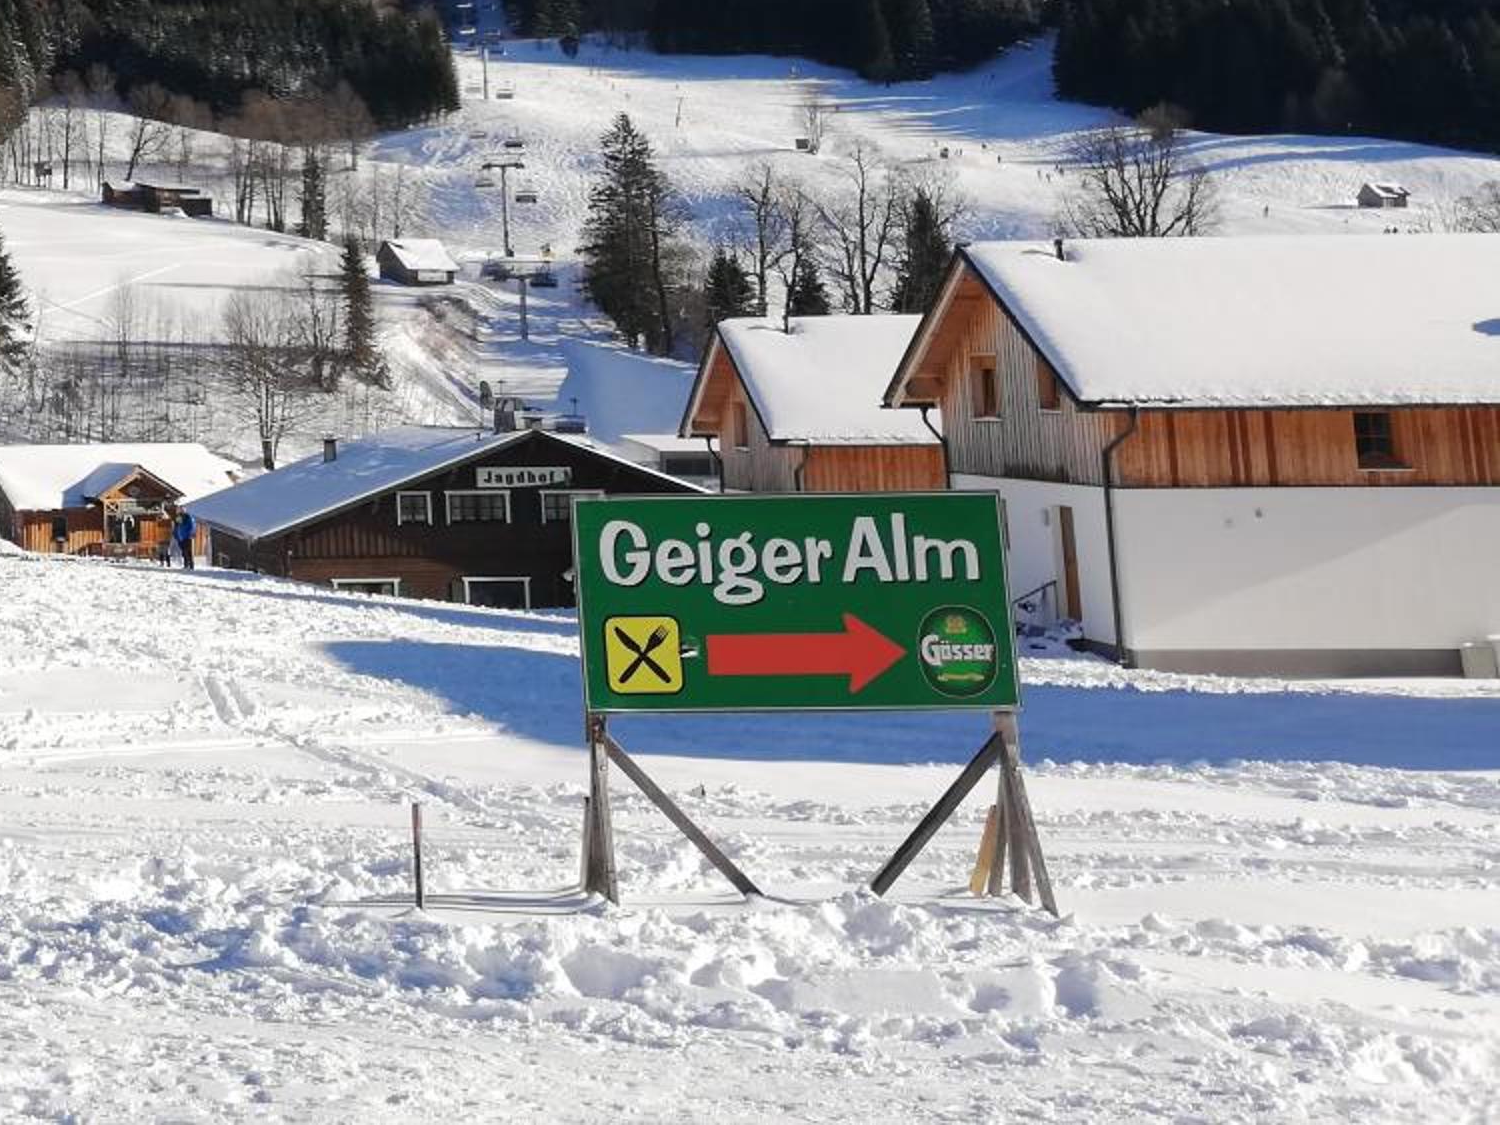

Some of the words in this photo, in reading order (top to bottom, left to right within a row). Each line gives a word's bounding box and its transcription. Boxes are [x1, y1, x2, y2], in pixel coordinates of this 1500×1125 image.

[599, 519, 833, 606] Geiger
[842, 512, 981, 583] Alm
[921, 634, 995, 666] Gösser
